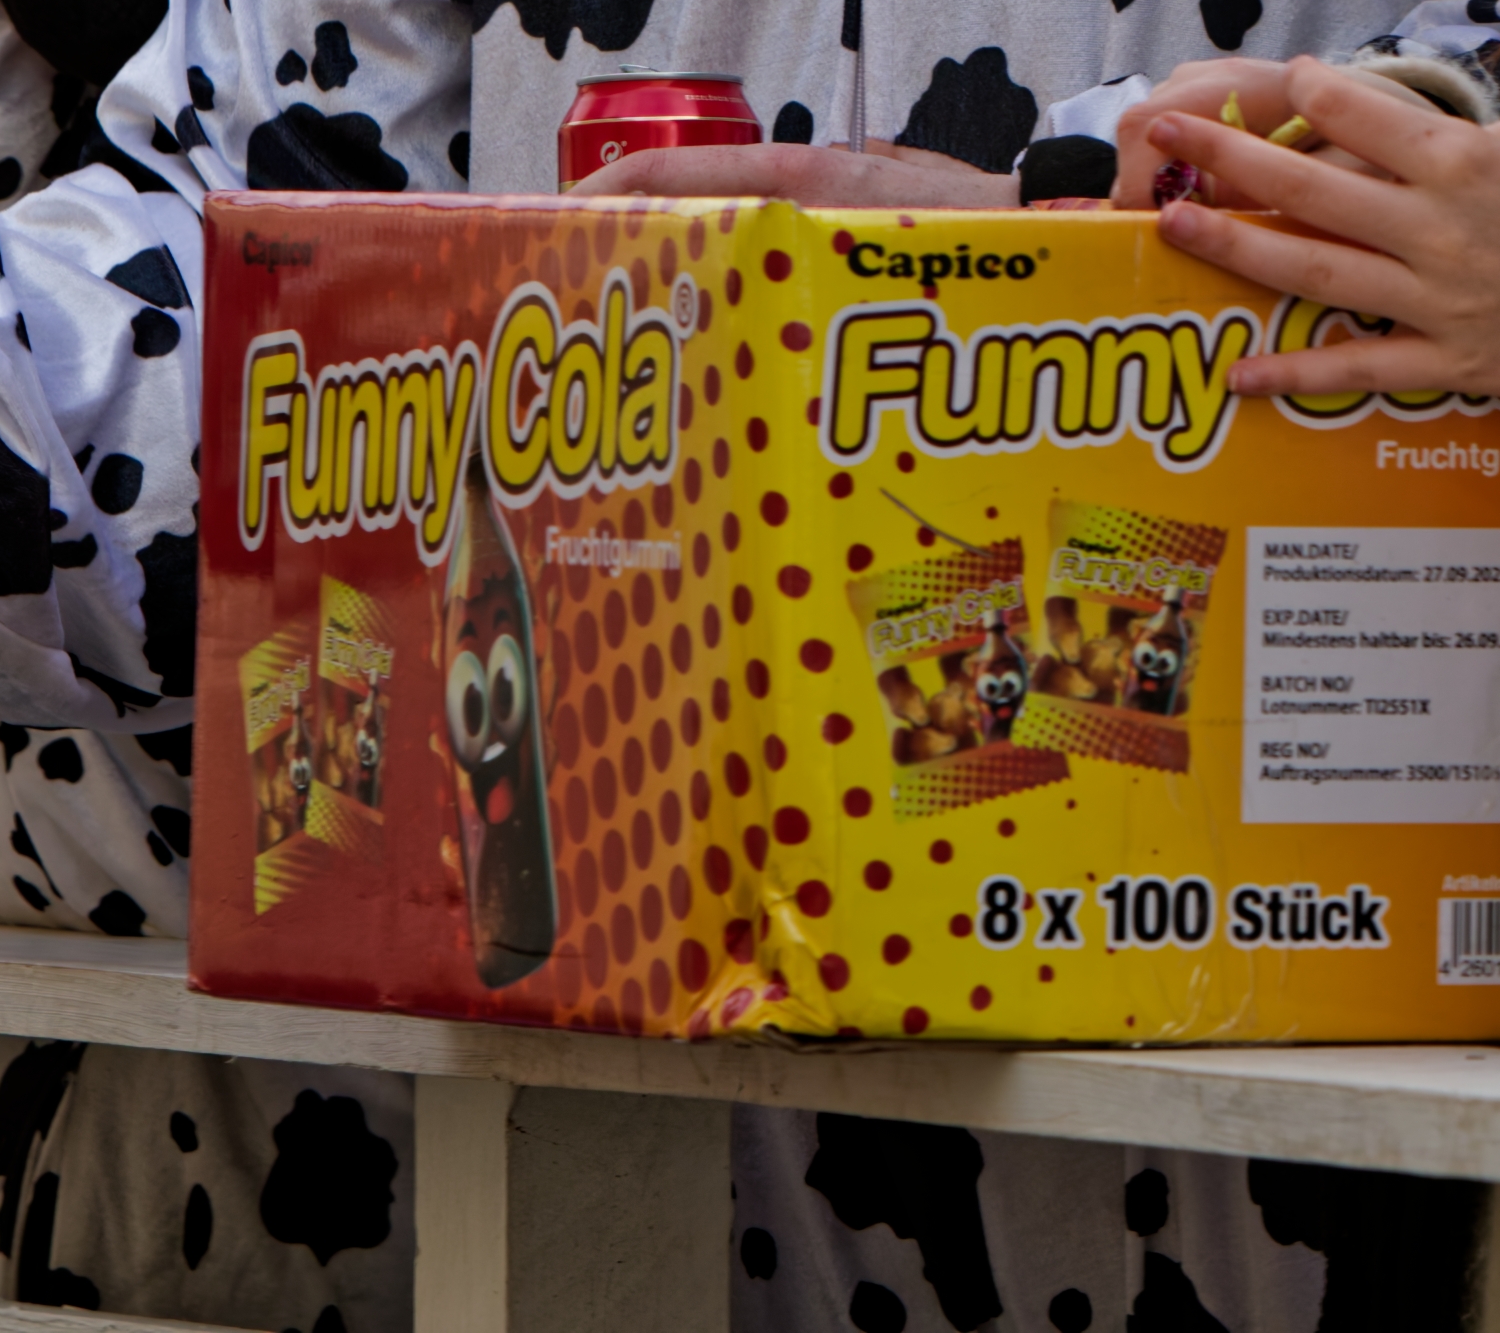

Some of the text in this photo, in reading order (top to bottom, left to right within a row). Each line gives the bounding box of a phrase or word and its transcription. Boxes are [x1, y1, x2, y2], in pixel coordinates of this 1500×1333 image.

[819, 300, 1261, 474] Funny
[240, 267, 682, 566] Funny Cola
[545, 526, 681, 578] Fruchtgummi
[1263, 566, 1420, 583] Produktionsdatum:
[1263, 632, 1357, 648] Mindestens
[1360, 632, 1418, 648] haltbar
[1422, 632, 1450, 648] bis:
[1261, 676, 1317, 692] BATCH
[1261, 699, 1362, 715] Lotnummer:
[1260, 742, 1293, 758] REG
[1260, 764, 1401, 784] Auftragsnummer:
[981, 879, 1384, 942] 8 x 100 Stück
